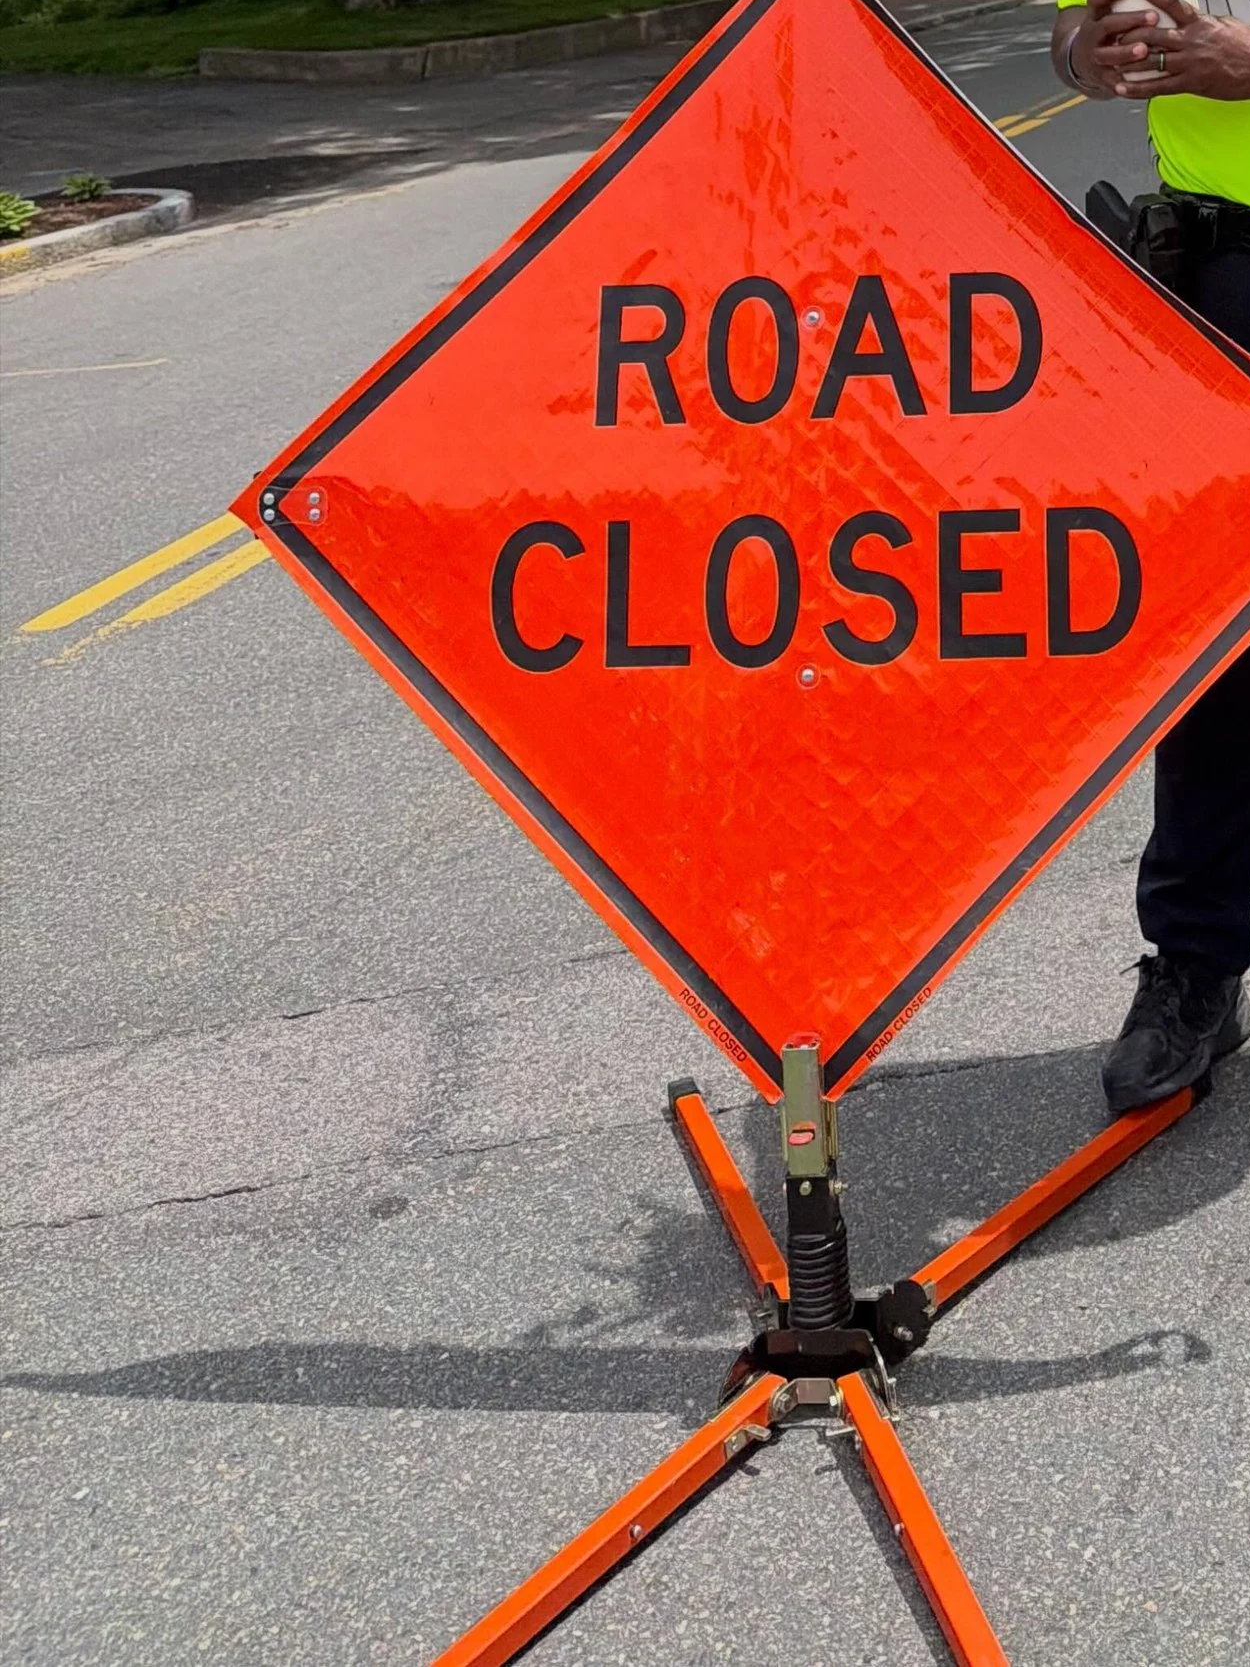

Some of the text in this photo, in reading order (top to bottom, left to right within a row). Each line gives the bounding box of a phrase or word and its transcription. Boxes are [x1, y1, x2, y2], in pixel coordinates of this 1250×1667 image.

[594, 271, 1044, 427] ROAD
[489, 506, 1142, 673] CLOSED
[679, 988, 748, 1062] ROAD CLOSED
[865, 987, 932, 1062] ROAD CLOSED
